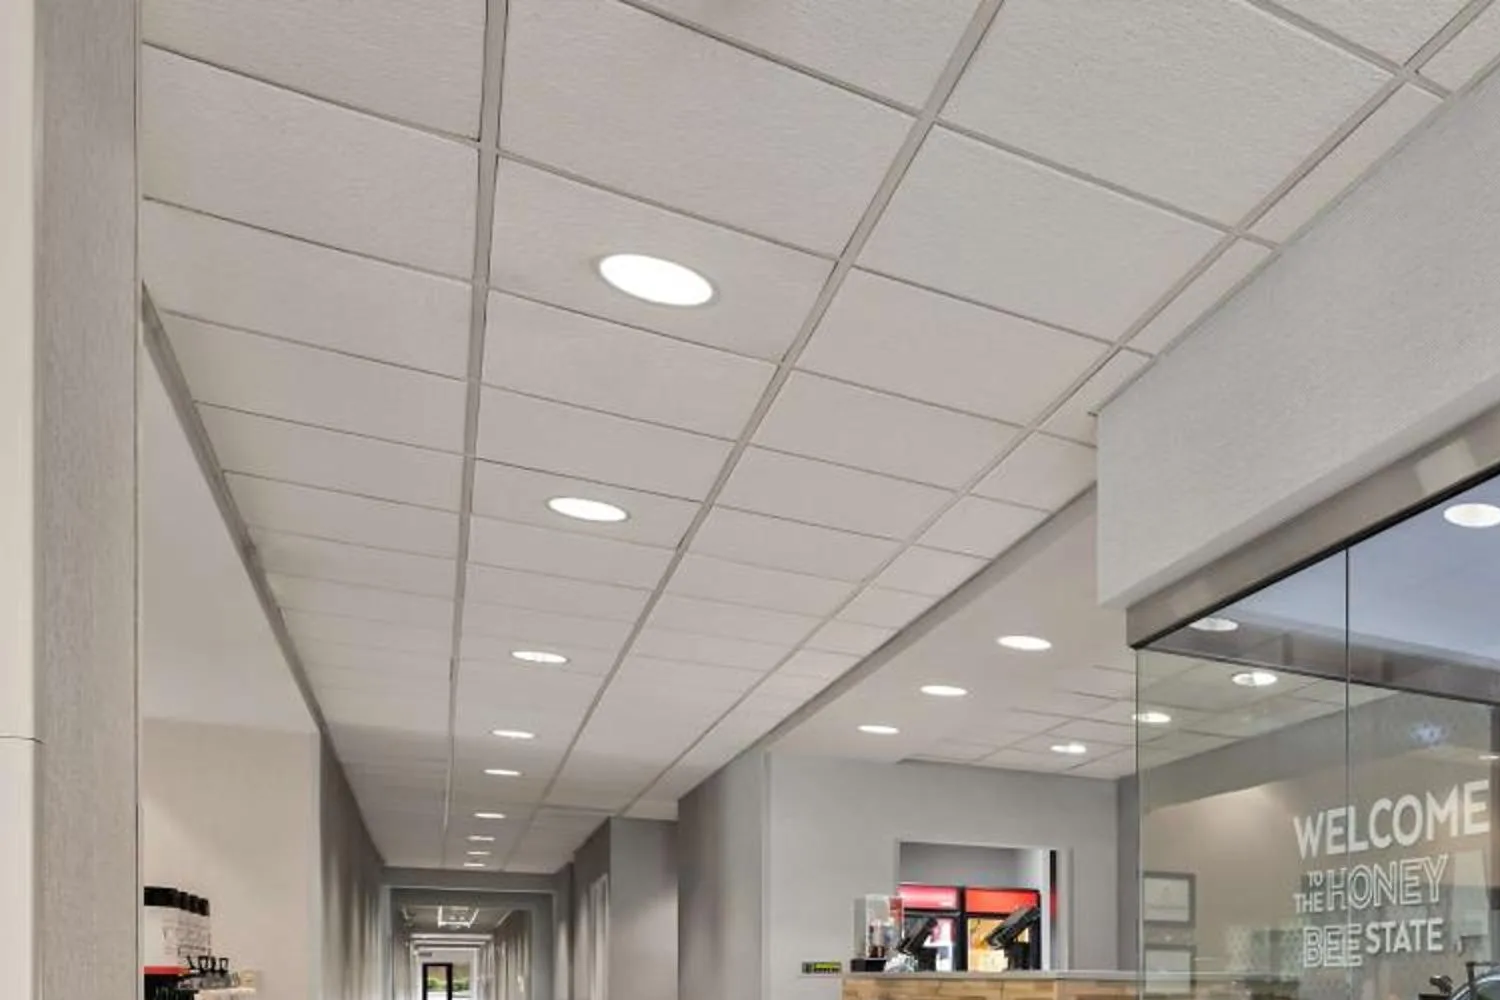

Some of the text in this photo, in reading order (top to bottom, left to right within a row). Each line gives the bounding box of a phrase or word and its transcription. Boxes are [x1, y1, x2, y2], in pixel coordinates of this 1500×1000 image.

[1293, 779, 1491, 860] WELCOME
[1293, 892, 1324, 914] THE
[1307, 870, 1323, 887] TO
[1326, 854, 1449, 910] HONEY
[1303, 917, 1444, 968] BEE STATE
